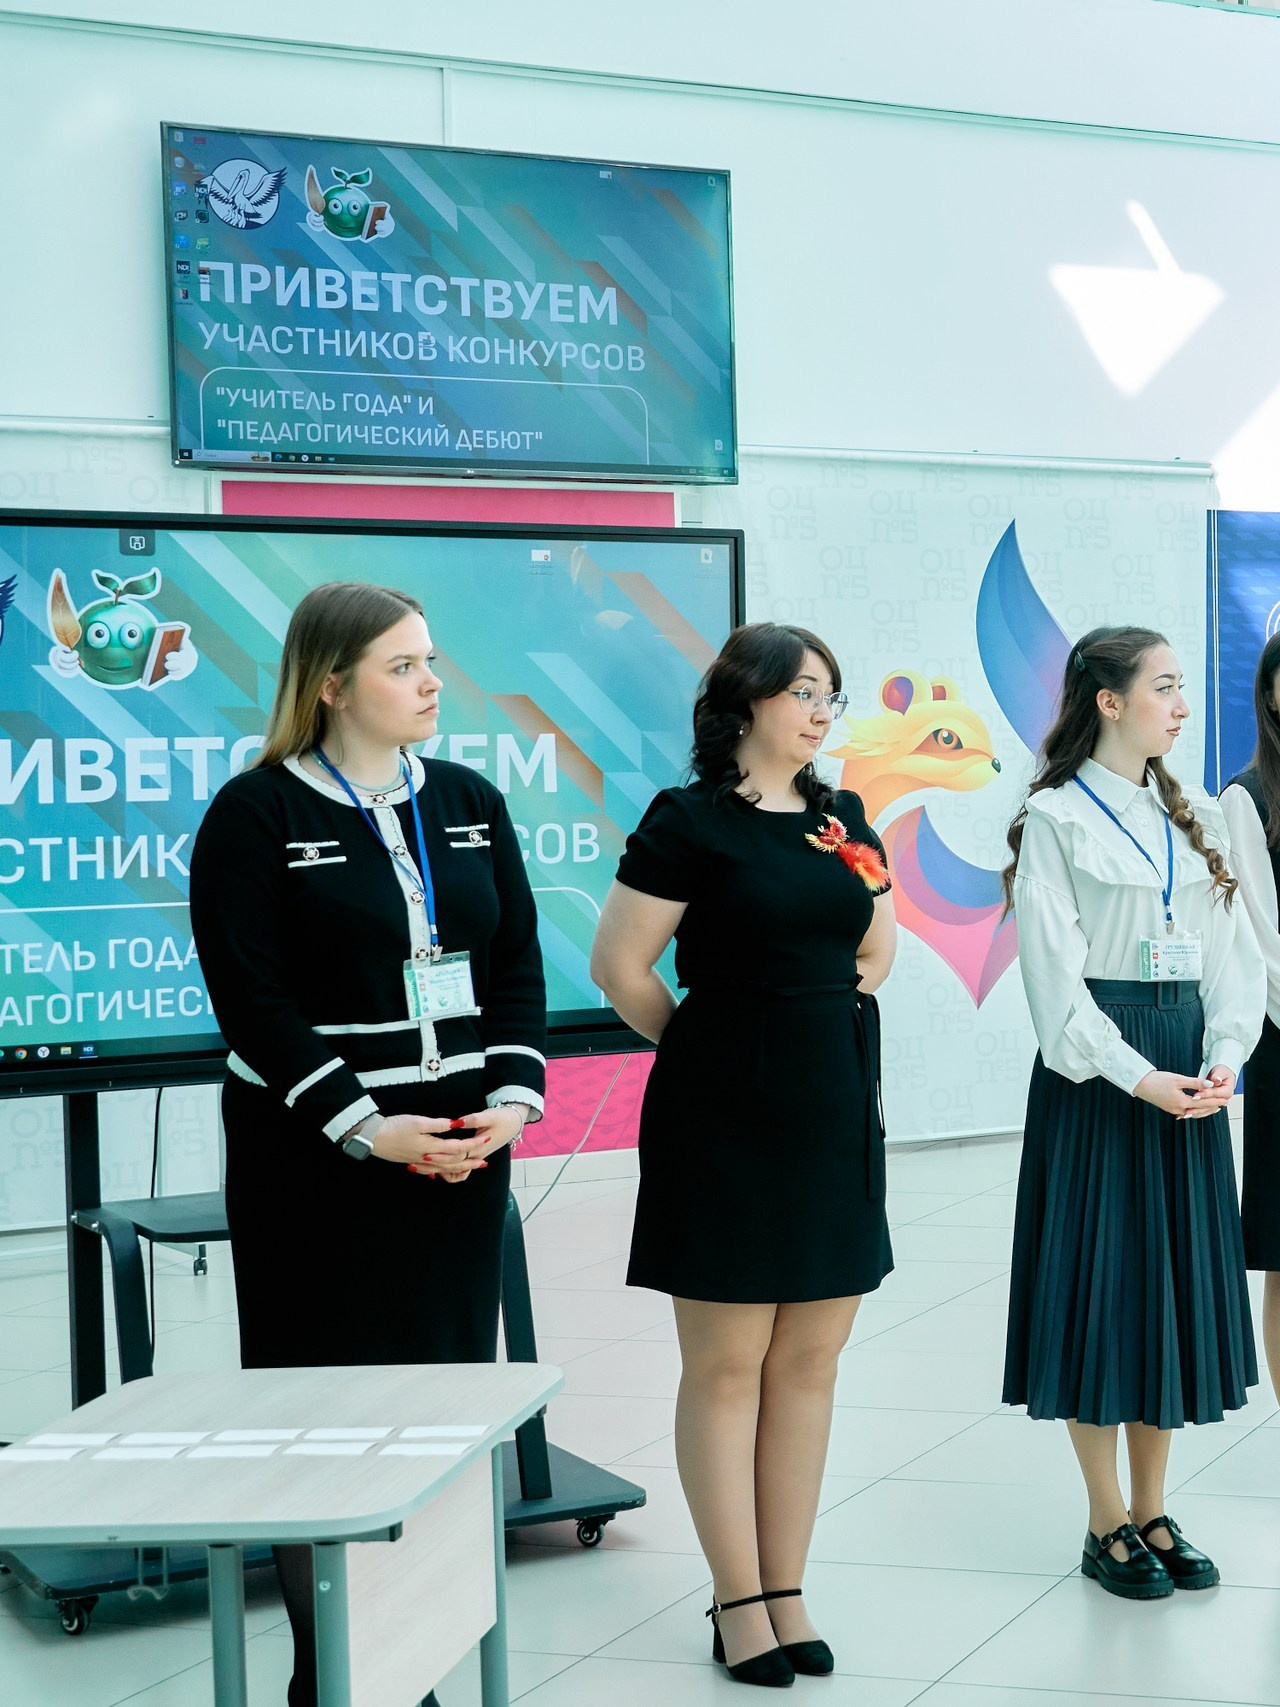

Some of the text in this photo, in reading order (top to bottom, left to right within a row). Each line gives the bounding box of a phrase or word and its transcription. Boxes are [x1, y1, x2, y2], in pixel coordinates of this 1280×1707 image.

[199, 261, 619, 325] ПРИВЕТСТВУЕМ
[198, 321, 647, 371] УЧАСТНИКОВ КОНКУРСОВ
[216, 387, 434, 416] "УЧИТЕЛЬ ГОДА" И
[217, 419, 543, 451] "ПЕДАГОГИЧЕСКИЙ ДЕБЮТ"
